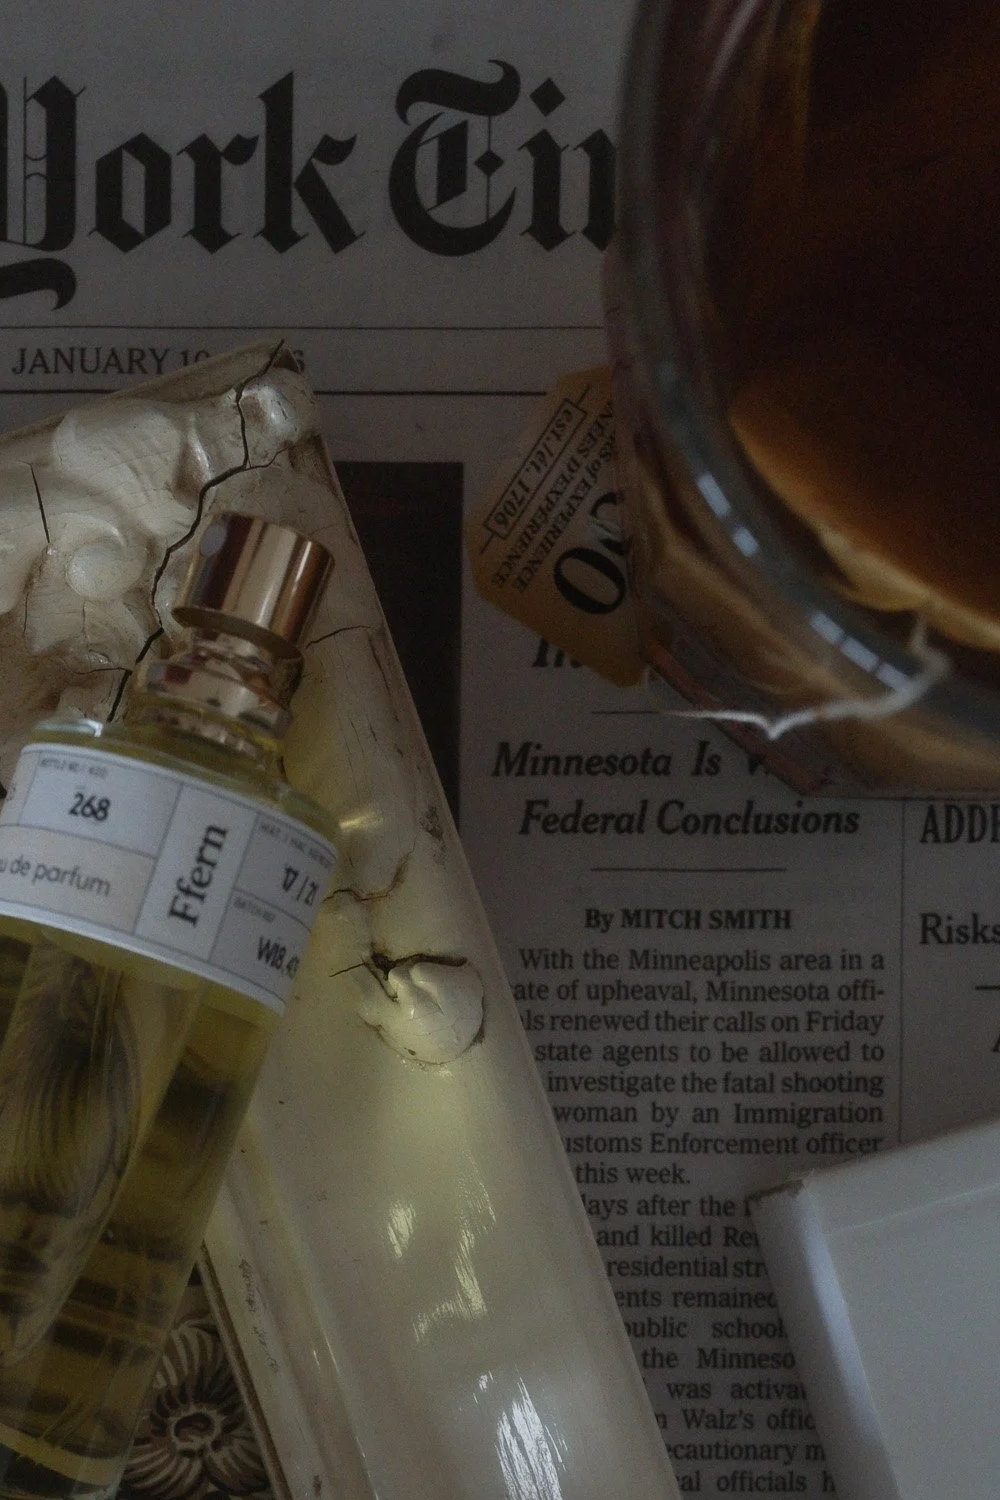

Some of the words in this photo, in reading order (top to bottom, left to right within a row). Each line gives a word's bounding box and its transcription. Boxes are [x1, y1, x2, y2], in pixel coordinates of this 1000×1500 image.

[389, 59, 617, 257] Ti
[10, 346, 171, 376] JANUARY
[494, 478, 531, 526] 1706
[491, 740, 672, 778] Minnesota
[691, 739, 722, 777] Is
[67, 791, 112, 823] 268
[518, 799, 650, 836] Federal
[656, 799, 861, 836] Conclusions
[9, 854, 33, 878] de
[31, 862, 113, 899] parfum
[167, 822, 229, 928] Ffern
[584, 908, 614, 933] By
[620, 909, 701, 930] MITCH
[708, 908, 793, 931] SMITH
[519, 947, 575, 971] With
[582, 948, 620, 971] the
[628, 948, 771, 976] Minneapolis
[779, 953, 833, 971] area
[839, 949, 862, 971] in
[870, 954, 886, 971] a
[556, 978, 579, 1002] of
[585, 979, 699, 1007] upheaval,
[705, 980, 831, 1003] Minnesota
[837, 979, 885, 1002] offi-
[549, 1010, 650, 1032] renewed
[654, 1010, 710, 1032] their
[712, 1011, 767, 1033] calls
[771, 1016, 799, 1033] on
[805, 1010, 885, 1037] Friday
[534, 1043, 593, 1063] state
[602, 1046, 680, 1068] agents
[688, 1043, 712, 1063] to
[721, 1040, 750, 1063] be
[759, 1040, 851, 1063] allowed
[861, 1043, 886, 1063] to
[546, 1071, 677, 1099] investigate
[681, 1071, 719, 1094] the
[721, 1070, 776, 1094] fatal
[781, 1071, 885, 1099] shooting
[553, 1105, 639, 1124] woman
[650, 1101, 680, 1128] by
[691, 1105, 720, 1124] an
[733, 1102, 885, 1128] Immigration
[649, 1133, 799, 1155] Enforcement
[806, 1132, 884, 1155] officer
[575, 1162, 619, 1185] this
[625, 1162, 692, 1185] week.
[636, 1195, 691, 1218] after
[700, 1194, 737, 1217] the
[596, 1224, 640, 1248] and
[650, 1224, 713, 1248] killed
[606, 1256, 729, 1279] residential
[711, 1317, 788, 1340] school
[641, 1347, 680, 1370] the
[666, 1381, 713, 1399] was
[681, 1408, 756, 1431] Walz's
[715, 1469, 808, 1493] officials
